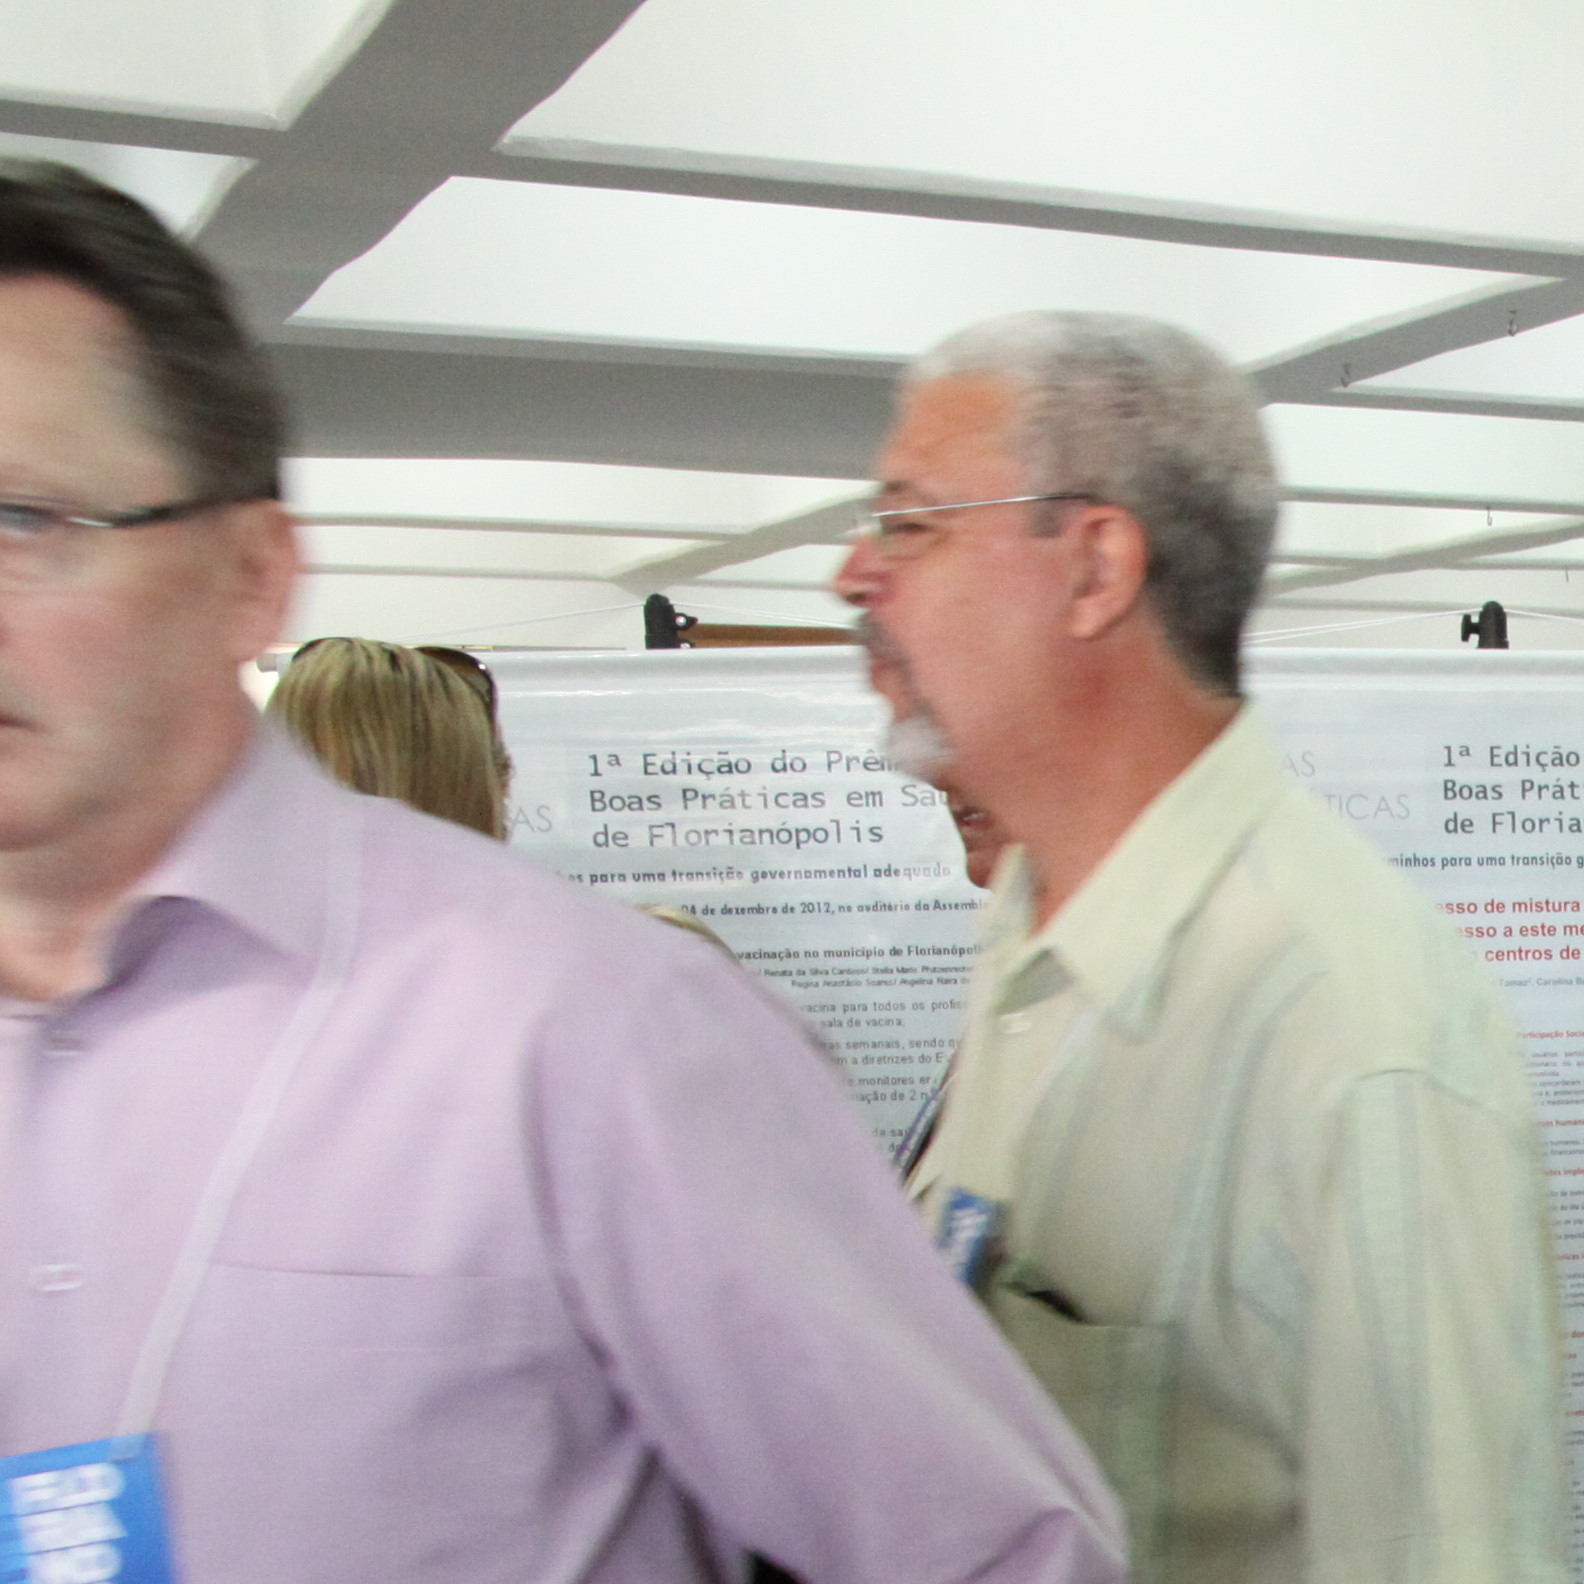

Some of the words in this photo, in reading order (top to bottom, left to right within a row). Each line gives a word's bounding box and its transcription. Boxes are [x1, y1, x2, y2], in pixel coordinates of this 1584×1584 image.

[589, 754, 622, 777] 1ª
[643, 752, 752, 783] Edição
[770, 749, 808, 775] do
[826, 748, 893, 774] Prê
[1443, 745, 1471, 769] 1ª
[1490, 743, 1581, 773] Edição
[591, 788, 662, 812] Boas
[682, 785, 826, 811] Práticas
[847, 789, 883, 809] em
[1443, 779, 1503, 801] Boas
[1325, 793, 1411, 821] TICAS
[1444, 811, 1474, 836] de
[593, 824, 630, 850] de
[648, 819, 885, 851] Florianópolis
[1441, 856, 1472, 870] para
[1477, 856, 1504, 867] uma
[1510, 852, 1572, 869] transição
[589, 869, 627, 886] para
[631, 871, 666, 883] uma
[671, 867, 744, 885] transição
[751, 863, 868, 884] governamental
[701, 903, 716, 915] de
[721, 903, 778, 915] dezembro
[781, 902, 796, 915] de
[800, 901, 836, 915] 2012,
[857, 901, 911, 914] auditório
[914, 900, 930, 912] da
[1484, 899, 1506, 914] de
[1512, 897, 1581, 913] mistura
[1503, 927, 1514, 938] a
[1519, 923, 1557, 938] este
[804, 950, 821, 959] no
[823, 945, 886, 962] município
[889, 946, 904, 957] de
[1485, 947, 1553, 962] centros
[1560, 945, 1582, 961] de
[843, 1003, 869, 1014] para
[873, 1001, 906, 1012] todos
[911, 1002, 925, 1011] os
[846, 1017, 861, 1028] de
[908, 1037, 945, 1048] sendo
[918, 1051, 932, 1062] do
[890, 1089, 905, 1101] de
